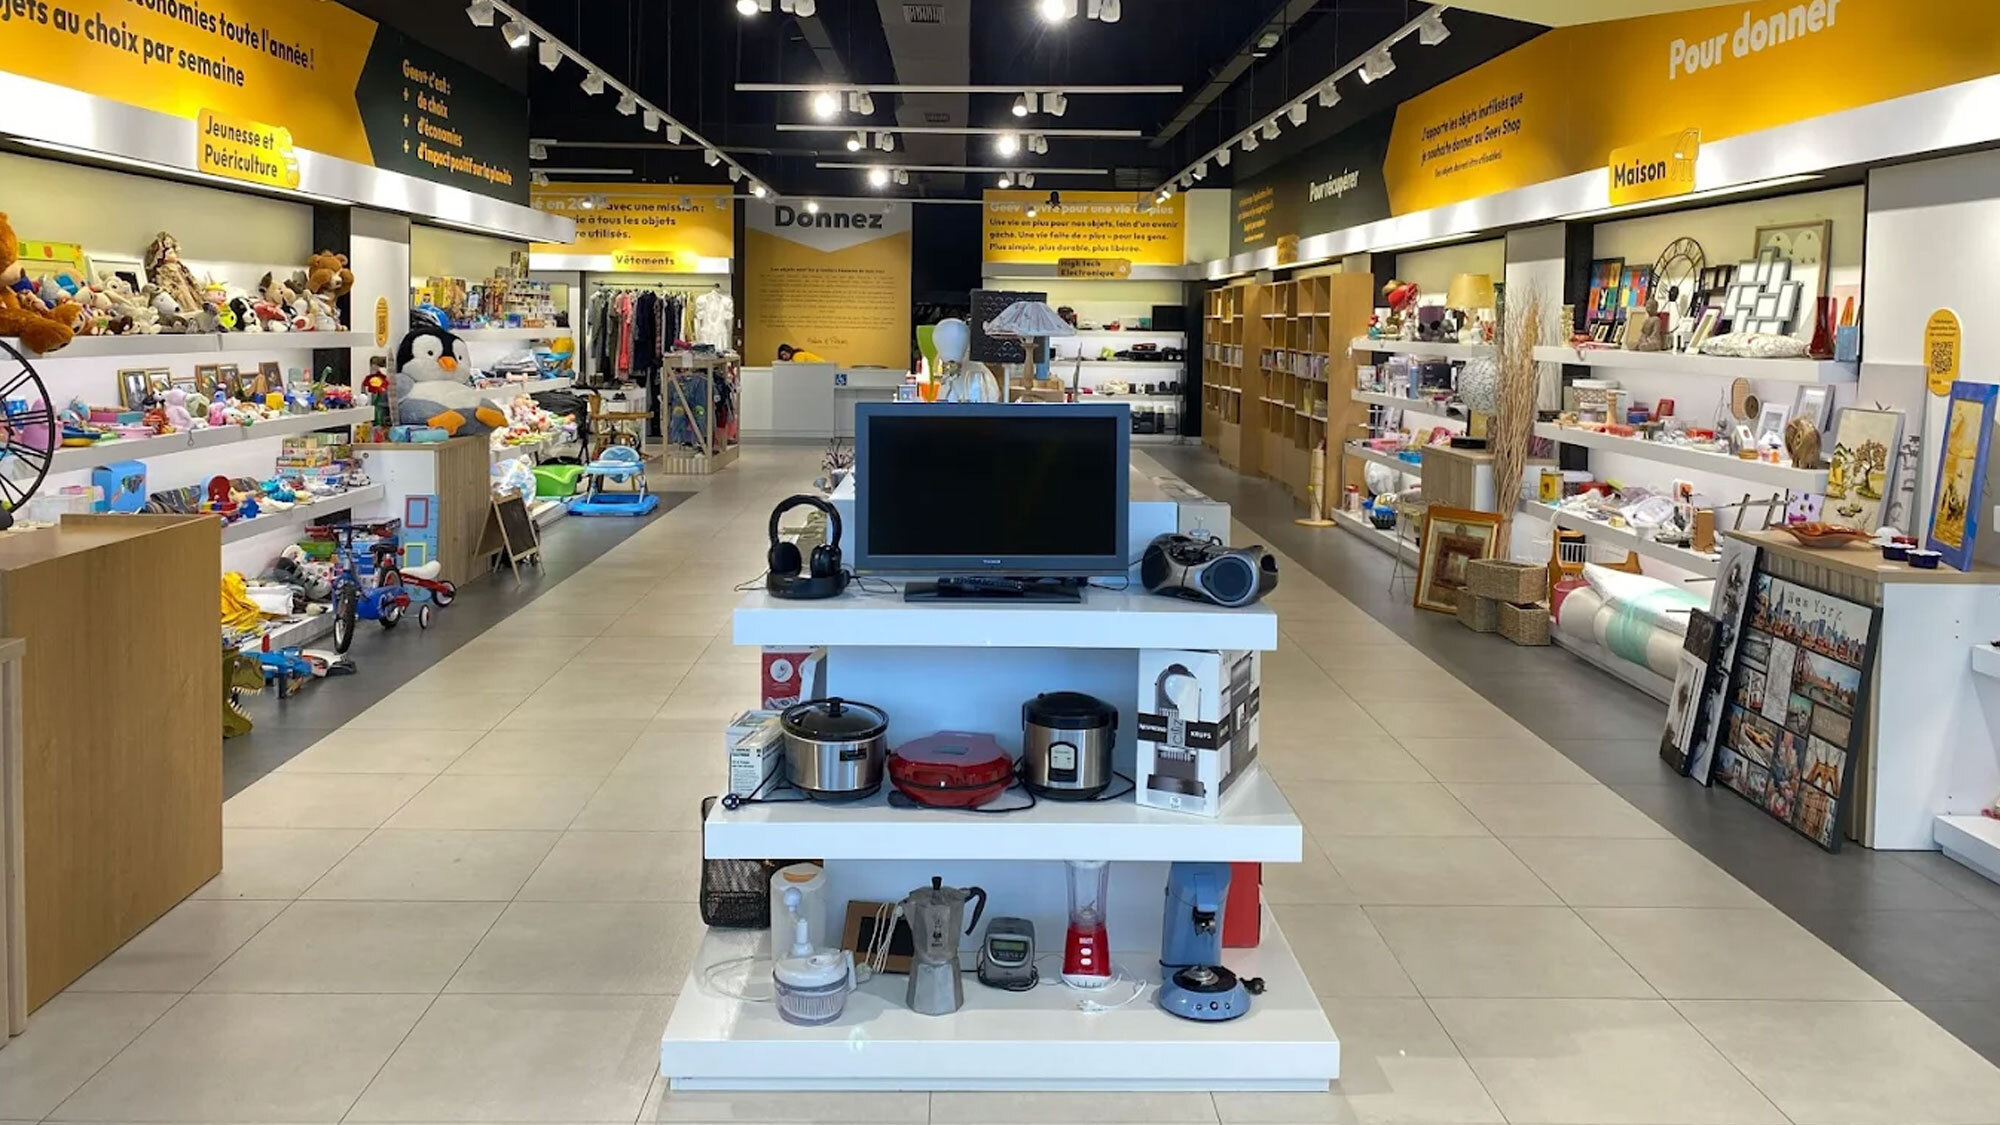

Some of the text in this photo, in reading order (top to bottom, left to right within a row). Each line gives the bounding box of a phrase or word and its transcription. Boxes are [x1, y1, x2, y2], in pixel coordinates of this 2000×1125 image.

[0, 0, 245, 87] jets au choix par semaine
[126, 0, 217, 34] onomies
[220, 12, 259, 51] toute
[261, 28, 309, 69] l'année
[1668, 0, 1841, 80] Pour donner
[417, 90, 428, 112] de
[427, 95, 449, 119] choix
[1509, 91, 1523, 111] que
[204, 115, 275, 151] Jeunesse et
[1452, 135, 1474, 153] donner
[1502, 118, 1522, 136] Shop
[204, 143, 279, 178] Puériculture
[1613, 158, 1667, 190] Maison
[546, 200, 566, 210] en
[606, 202, 632, 212] avec
[634, 203, 655, 212] une
[774, 204, 883, 230] Donnez
[1062, 204, 1089, 216] pour
[1090, 205, 1112, 214] une
[1113, 203, 1131, 214] vie
[1148, 203, 1174, 217] plus
[588, 214, 596, 225] à
[597, 215, 622, 226] tous
[623, 215, 640, 226] les
[641, 215, 677, 229] objets
[989, 218, 1006, 226] Une
[1007, 218, 1019, 226] vie
[1032, 219, 1049, 228] plus
[1050, 220, 1069, 228] pour
[1115, 219, 1132, 228] loin
[1132, 219, 1151, 228] d'un
[1151, 220, 1178, 228] avenir
[1018, 231, 1035, 239] Une
[1036, 231, 1048, 239] vie
[1049, 231, 1069, 239] faite
[1071, 231, 1081, 239] de
[1133, 232, 1145, 240] les
[989, 243, 1007, 251] Plus
[1092, 244, 1109, 253] plus
[615, 254, 676, 266] Vêtements
[1190, 730, 1212, 740] KRUPS
